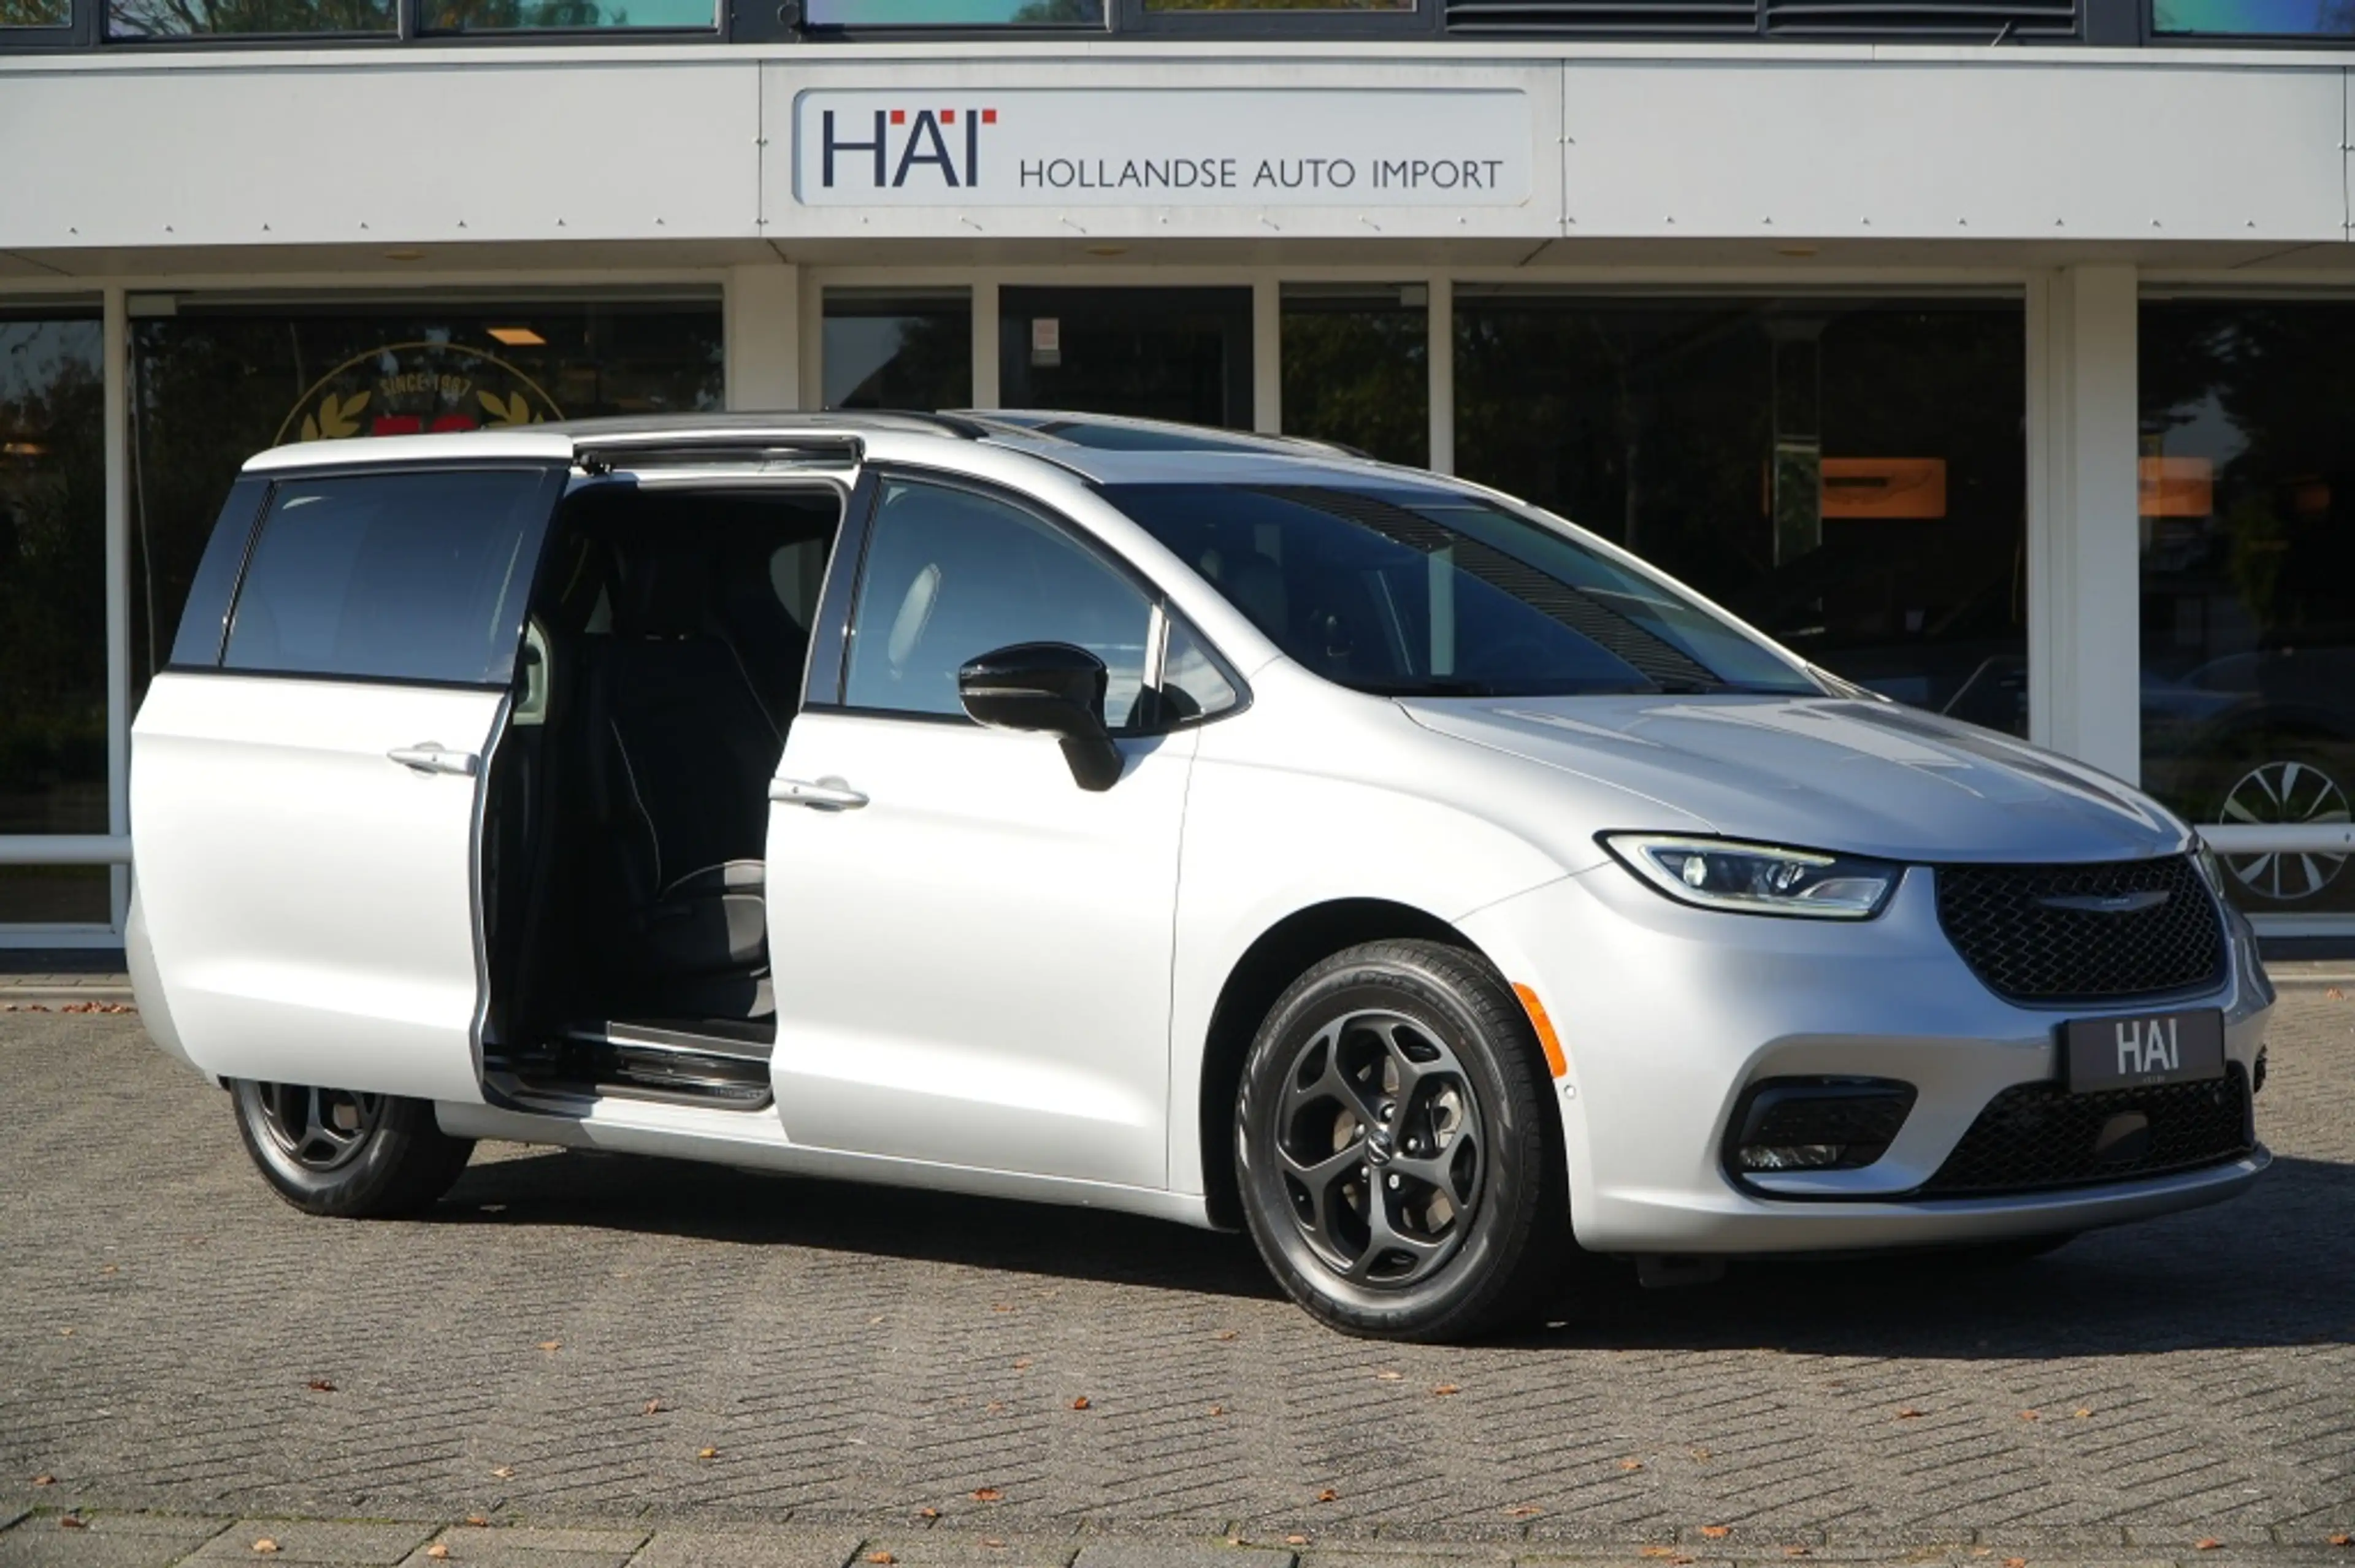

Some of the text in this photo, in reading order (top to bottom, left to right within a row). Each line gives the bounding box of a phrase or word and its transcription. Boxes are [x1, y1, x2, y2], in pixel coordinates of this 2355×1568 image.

[822, 110, 997, 188] HAI
[1020, 158, 1503, 188] HOLLANDSE AUTO IMPORT
[379, 372, 426, 397] SINCE
[2115, 1018, 2179, 1074] HAI
